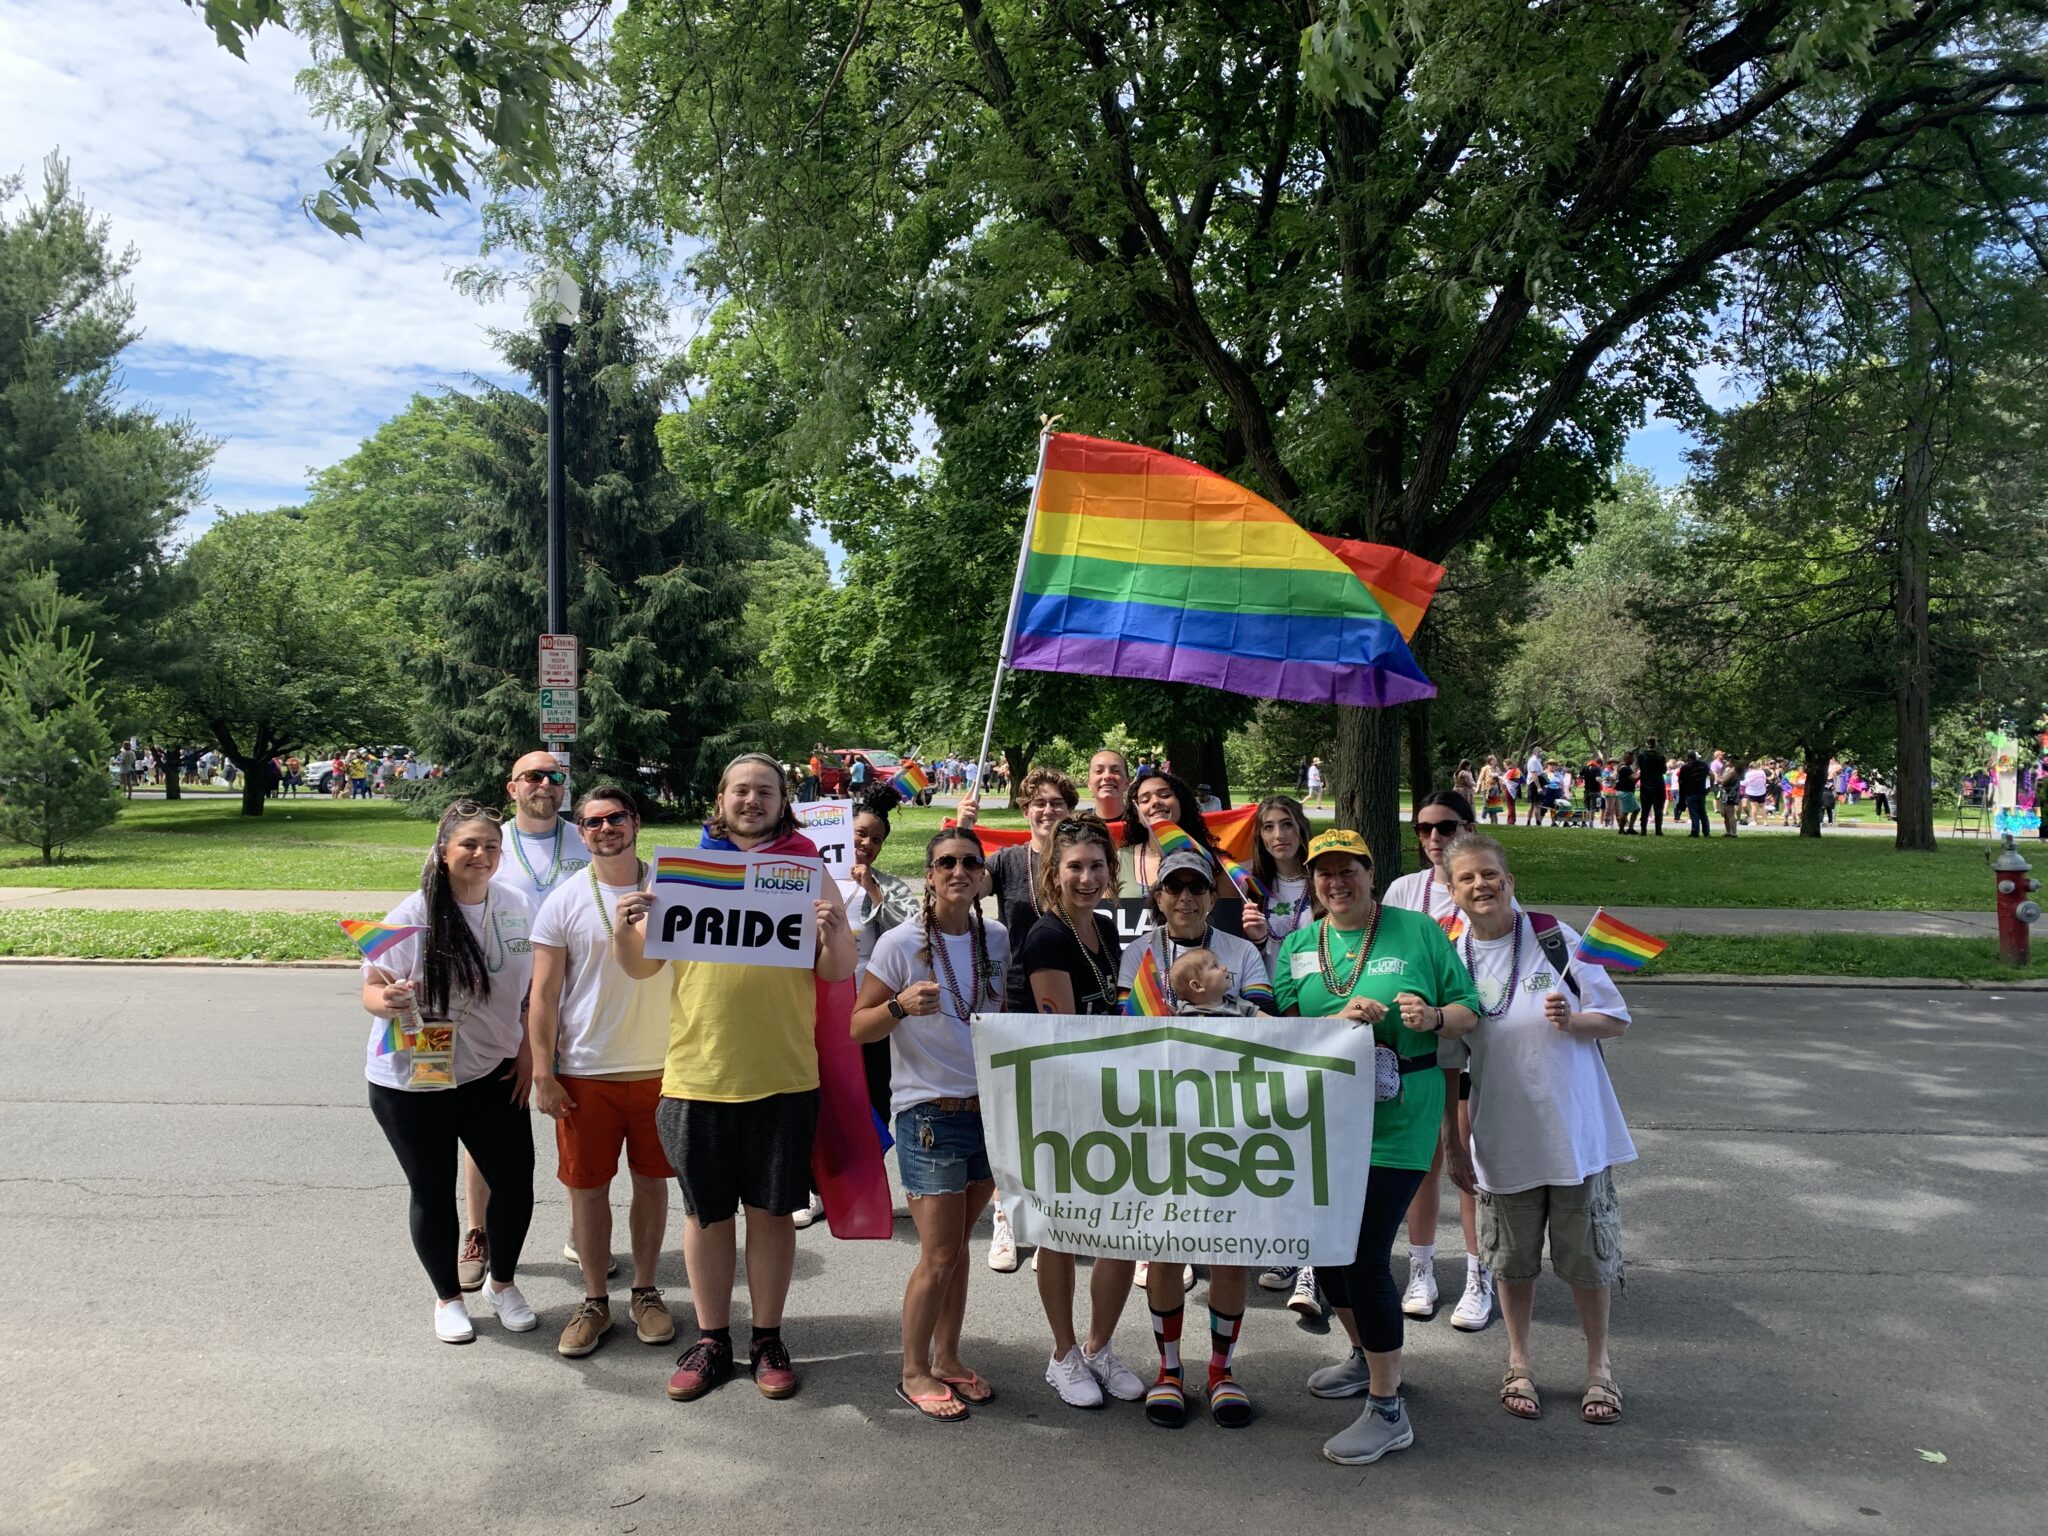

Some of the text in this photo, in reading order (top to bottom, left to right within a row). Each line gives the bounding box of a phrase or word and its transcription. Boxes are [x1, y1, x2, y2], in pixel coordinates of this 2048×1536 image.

[541, 637, 575, 648] NO PARKING
[542, 692, 552, 706] 2
[552, 699, 575, 707] PARKING
[819, 844, 845, 863] CT
[754, 864, 805, 891] house
[662, 905, 803, 950] PRIDE
[1015, 1060, 1295, 1198] house
[1031, 1194, 1237, 1230] Making Life Better
[1047, 1227, 1310, 1259] www.unityhouseny.org
